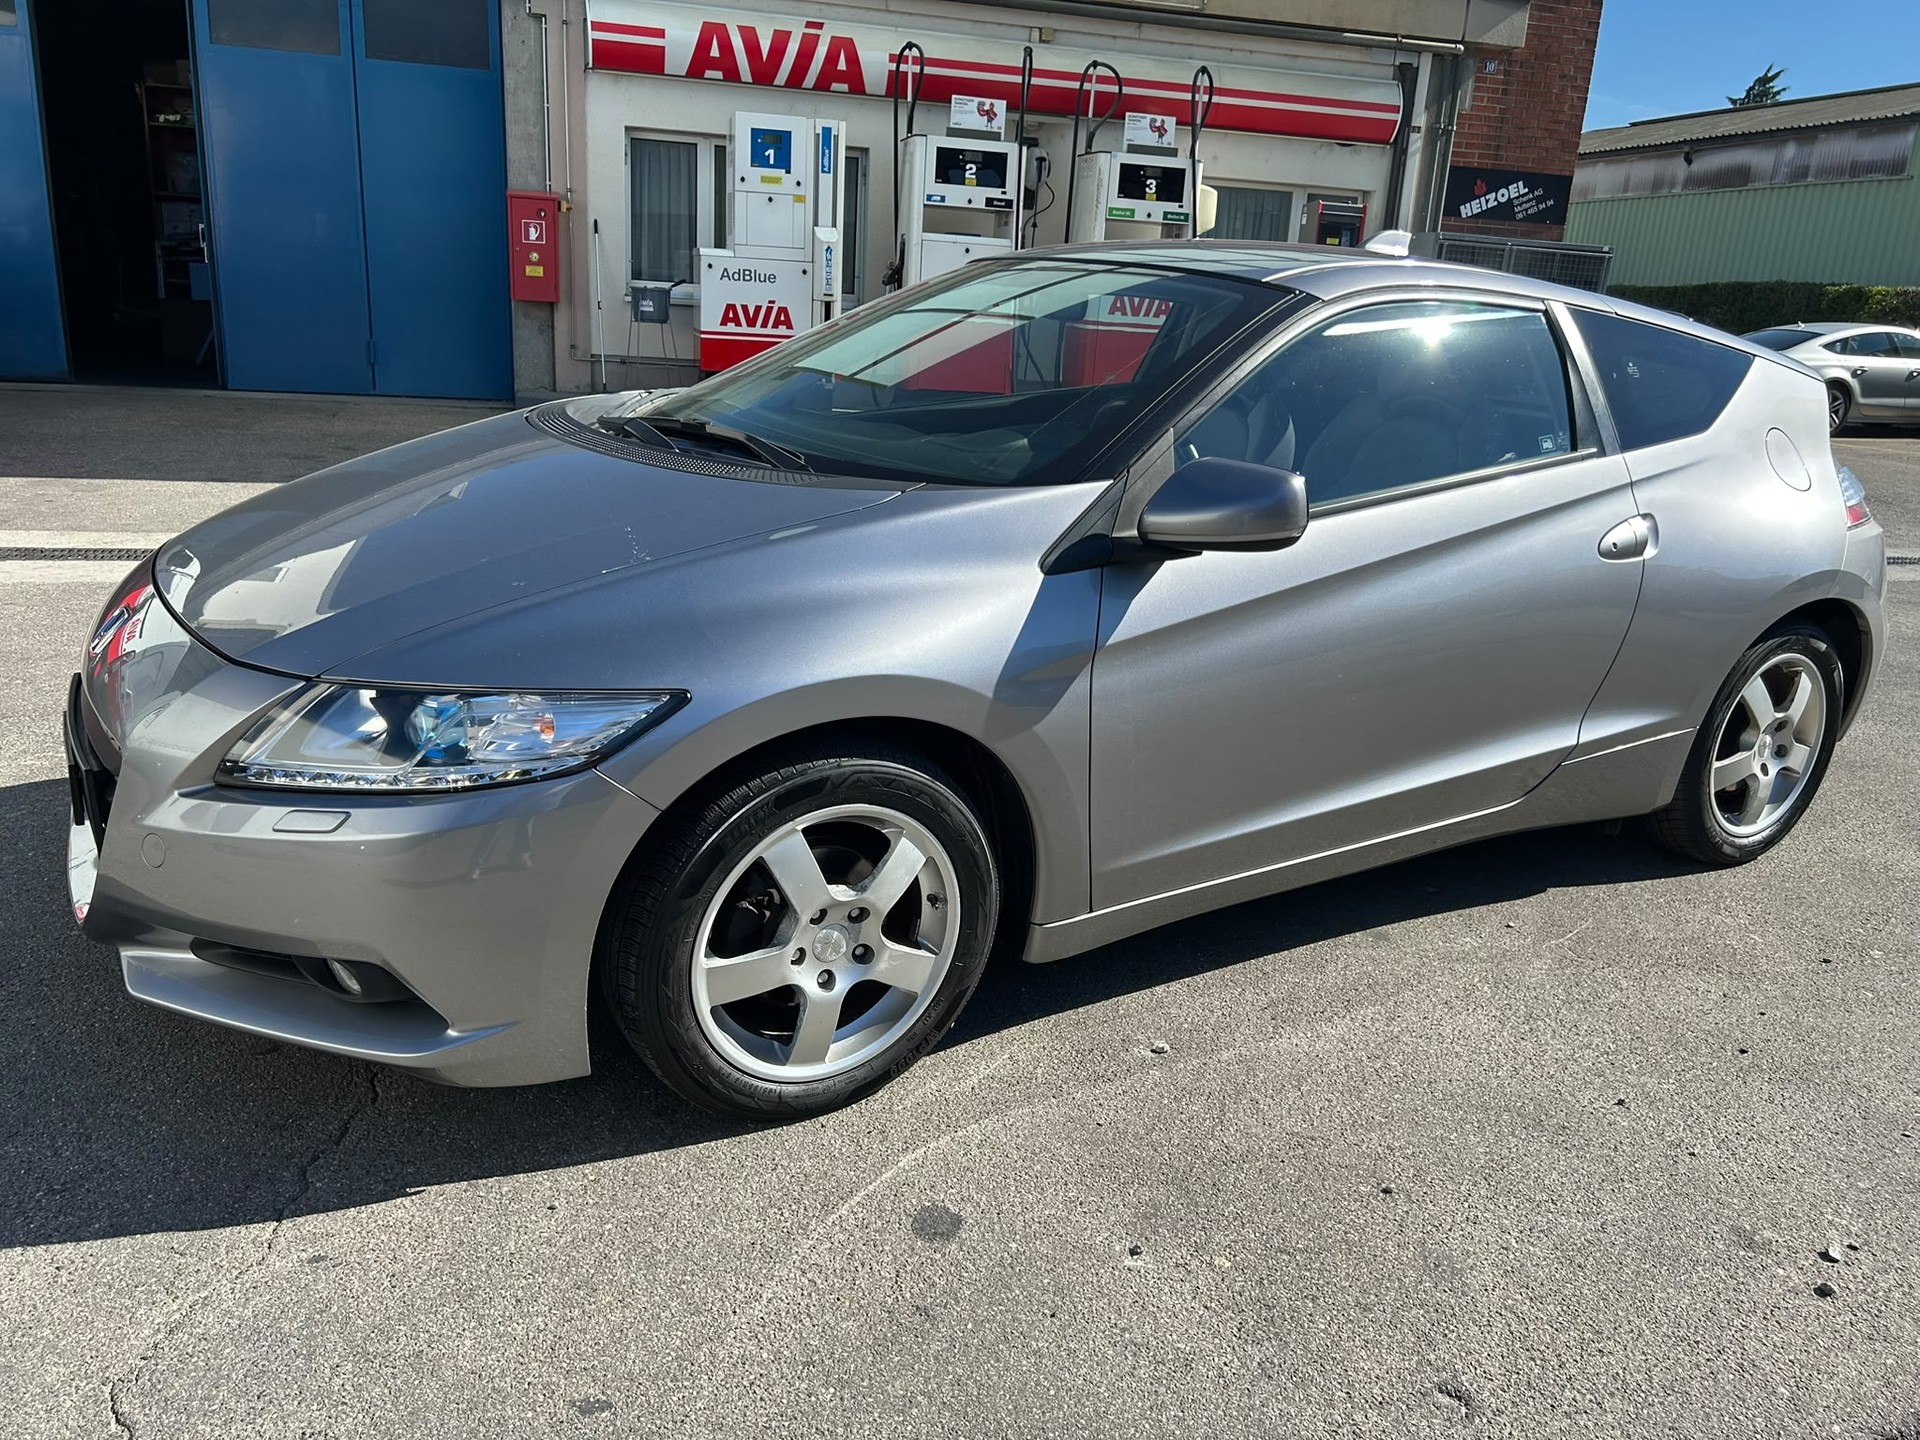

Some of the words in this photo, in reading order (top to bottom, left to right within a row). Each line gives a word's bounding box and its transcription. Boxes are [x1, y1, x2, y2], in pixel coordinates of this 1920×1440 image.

[685, 20, 867, 95] AVIA
[764, 148, 775, 165] 1
[965, 163, 977, 179] 2
[1145, 179, 1157, 193] 3
[1460, 180, 1529, 218] HEIZOEL
[1512, 192, 1534, 206] Schenk
[1533, 188, 1544, 198] AG
[1514, 200, 1536, 213] Muttenz
[720, 267, 777, 284] AdBlue
[719, 300, 794, 330] AVIA
[1109, 295, 1172, 319] AVIA
